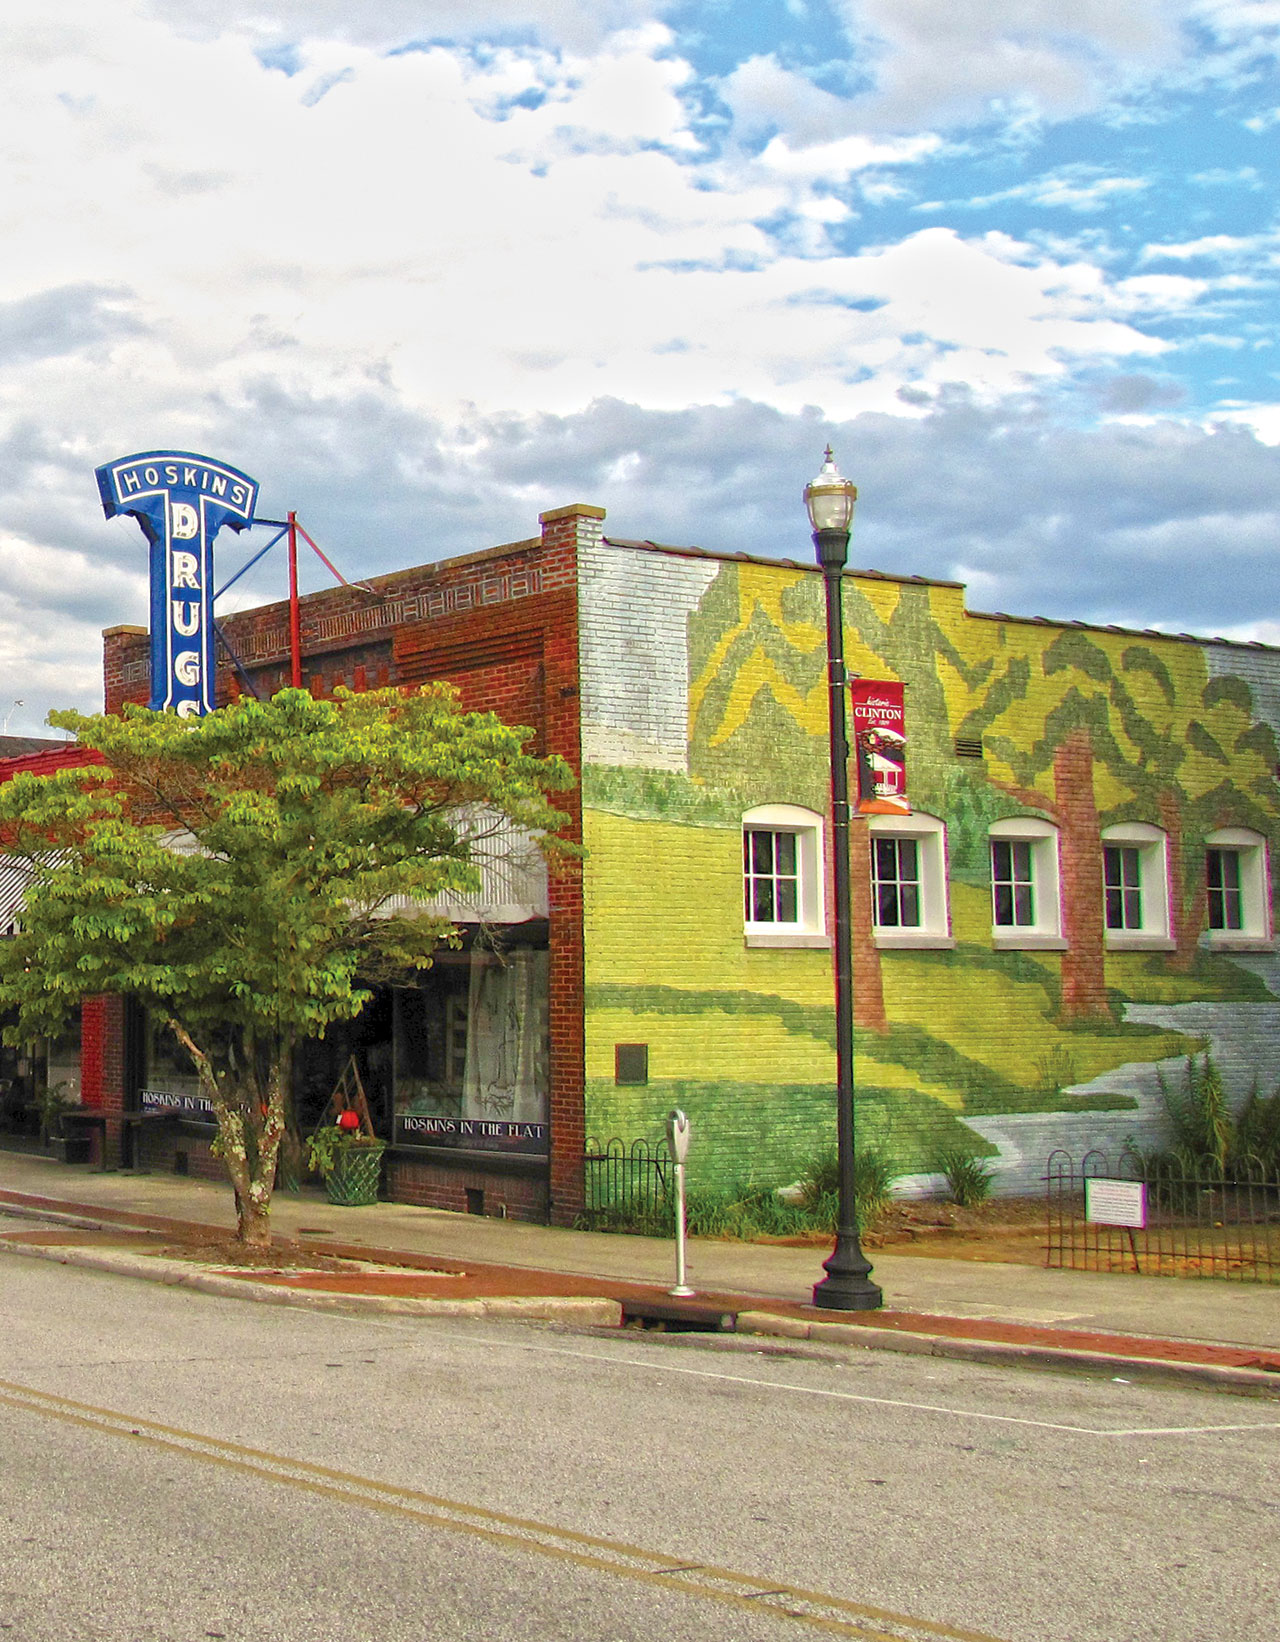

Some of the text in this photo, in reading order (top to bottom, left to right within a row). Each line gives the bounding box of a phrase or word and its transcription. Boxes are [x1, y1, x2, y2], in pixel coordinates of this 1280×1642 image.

[123, 465, 246, 505] HOSKINS
[854, 706, 902, 720] CLINTON
[142, 1091, 181, 1107] HOSKINS
[184, 1096, 196, 1109] IN
[198, 1098, 213, 1112] TH
[404, 1117, 545, 1138] HOSKINS IN THE FLAT
